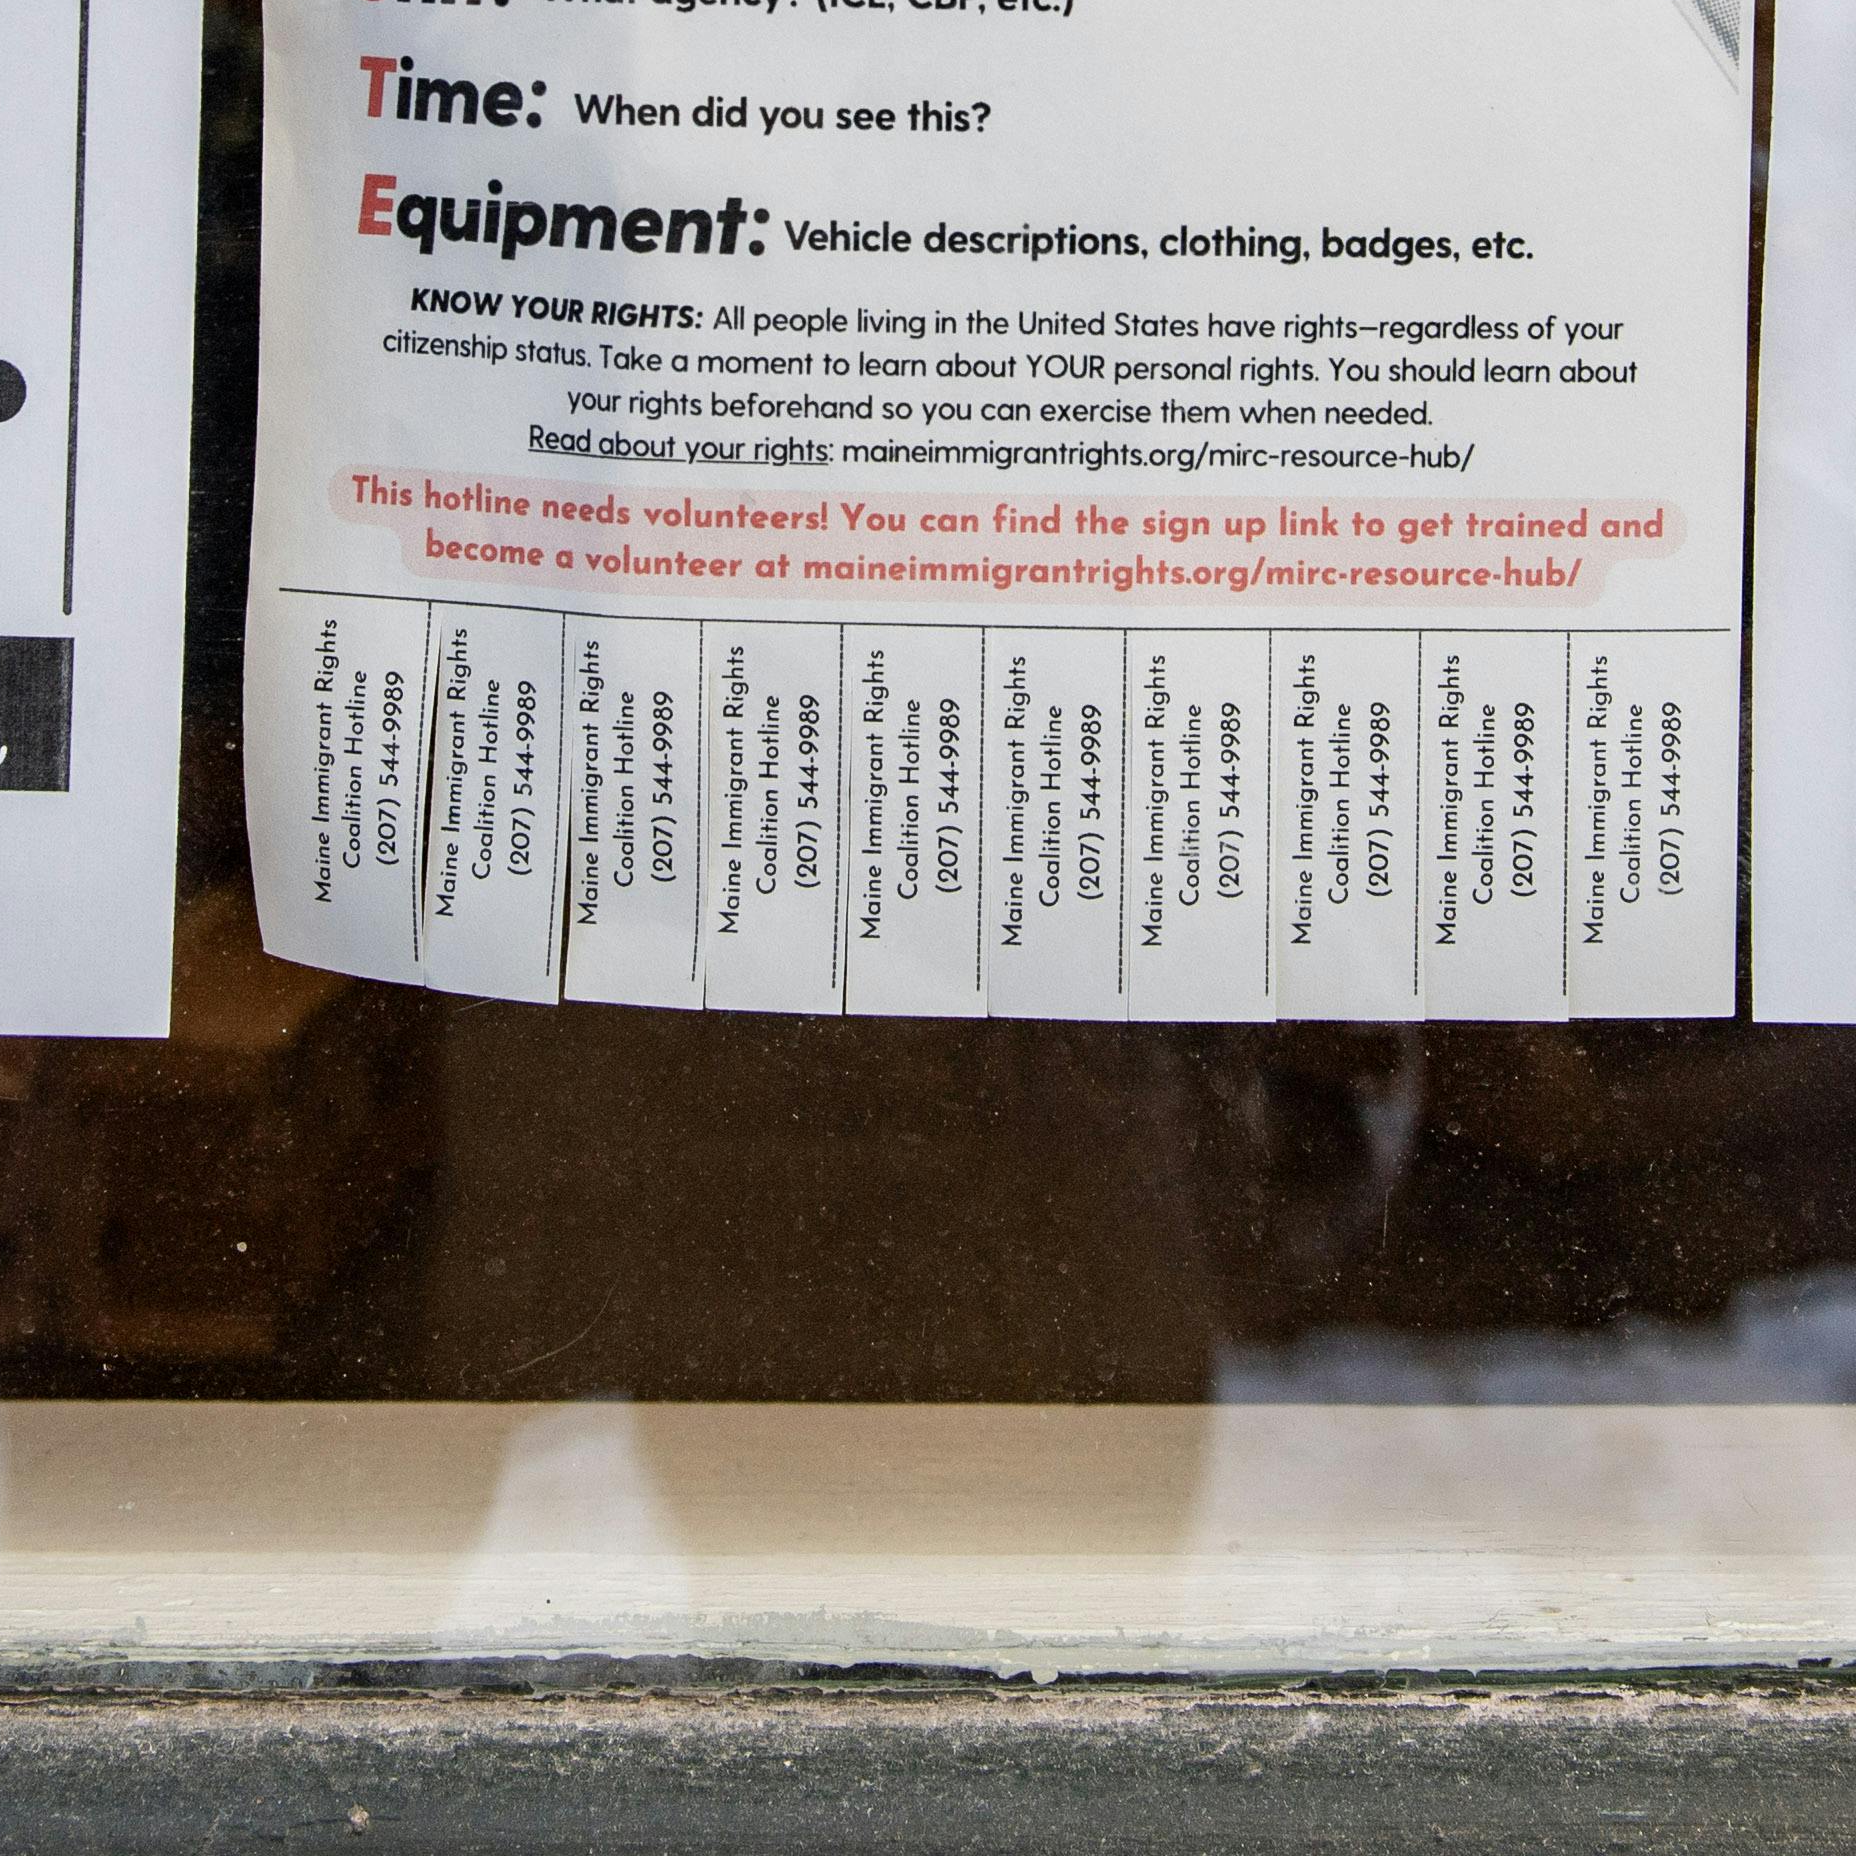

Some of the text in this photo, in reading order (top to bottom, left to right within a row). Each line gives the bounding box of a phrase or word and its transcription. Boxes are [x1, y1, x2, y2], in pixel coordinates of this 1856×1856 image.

[360, 56, 546, 128] Time:
[574, 94, 991, 135] When did you see this?
[359, 174, 769, 260] Equipment:
[785, 220, 1533, 265] Vehicle descriptions, clothing, badges, etc.
[426, 527, 1581, 592] become a volunteer at maineimmigrantrights.org/mirc-resource-hub/
[311, 620, 339, 902] Maine Immigrant Rights
[341, 671, 366, 868] Coalition Hotline
[376, 671, 404, 865] (207) 544-9989
[1583, 656, 1612, 943] Maine Immigrant Rights
[1619, 704, 1642, 903] Coalition Hotline
[1658, 702, 1684, 895] (207) 544-9989
